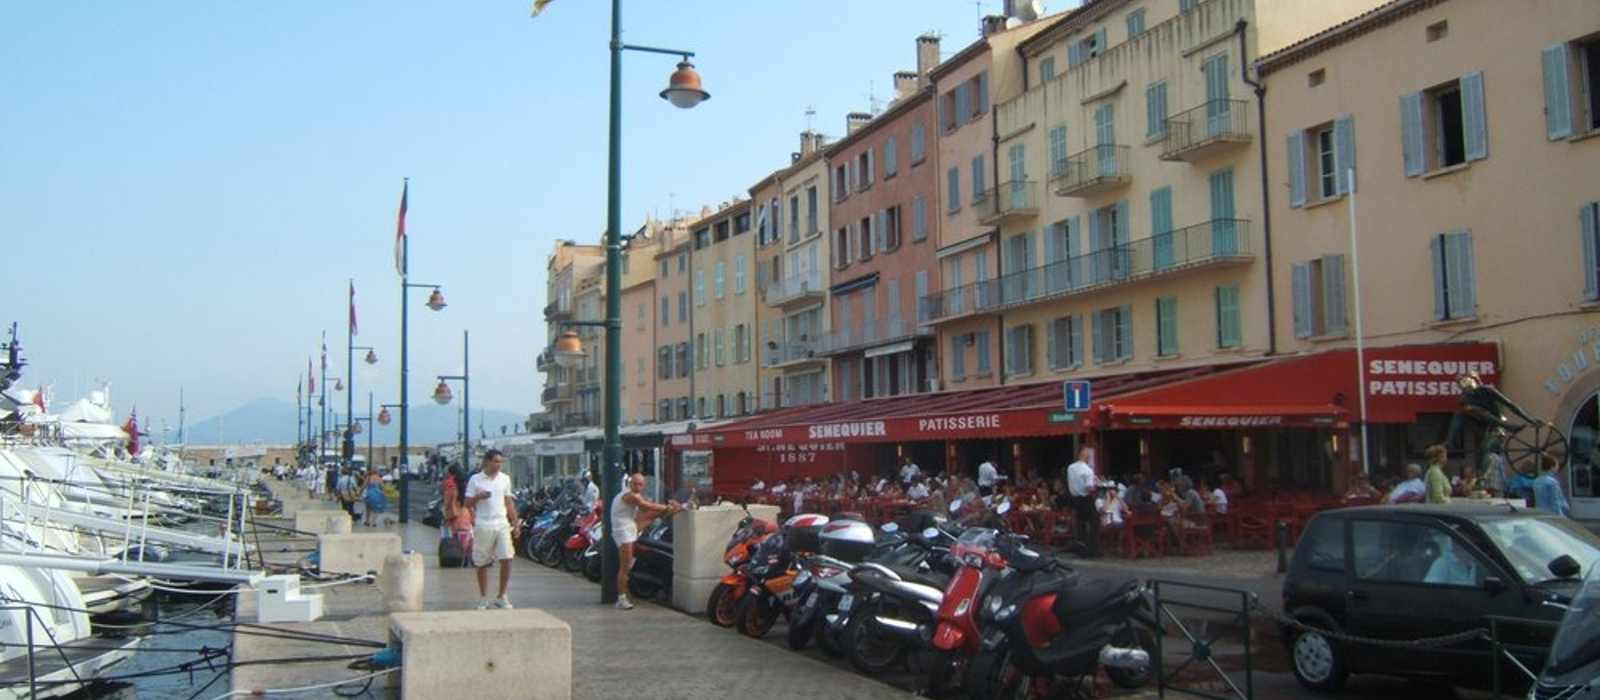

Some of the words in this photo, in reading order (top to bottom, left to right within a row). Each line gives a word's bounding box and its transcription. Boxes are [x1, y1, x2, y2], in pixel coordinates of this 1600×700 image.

[1369, 360, 1495, 374] SENEQUIER
[1369, 381, 1494, 395] PATISSER
[919, 414, 1000, 431] PATISSERIE
[1181, 416, 1282, 426] SENEQUIER
[808, 421, 886, 439] SENEQUIER
[780, 452, 817, 463] 1887
